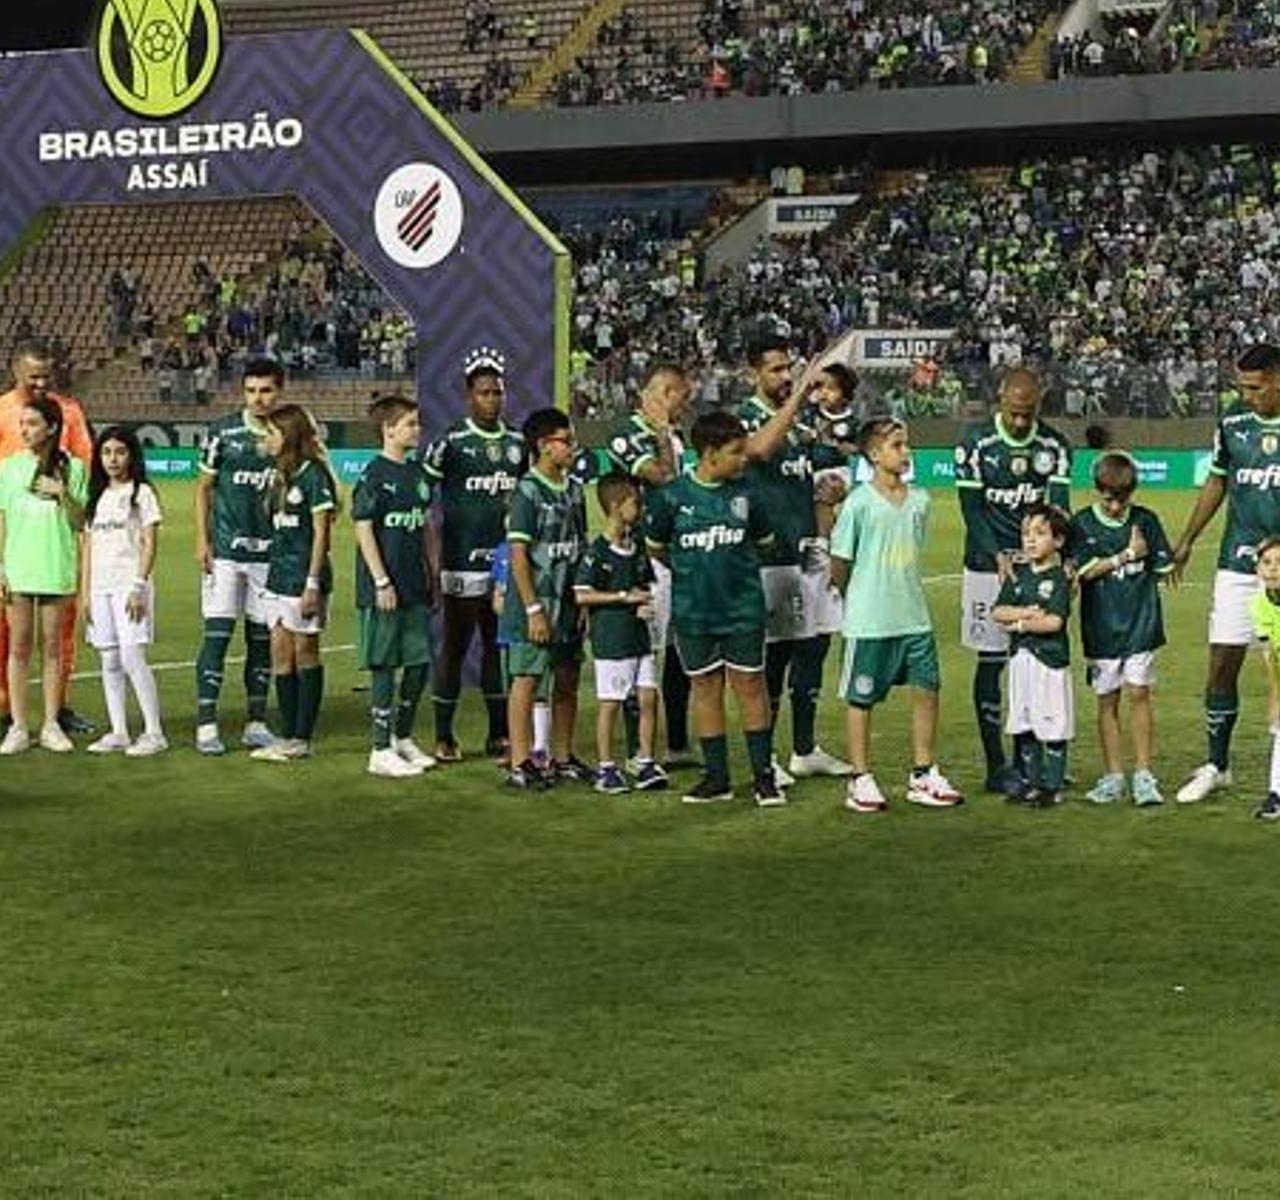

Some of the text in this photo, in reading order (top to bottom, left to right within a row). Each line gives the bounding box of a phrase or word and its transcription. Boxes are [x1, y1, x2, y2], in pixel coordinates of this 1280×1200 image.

[39, 112, 303, 161] BRASILEIRÃO
[126, 159, 209, 190] ASSAÍ
[986, 483, 1043, 509] crefis
[680, 524, 745, 552] crefisa
